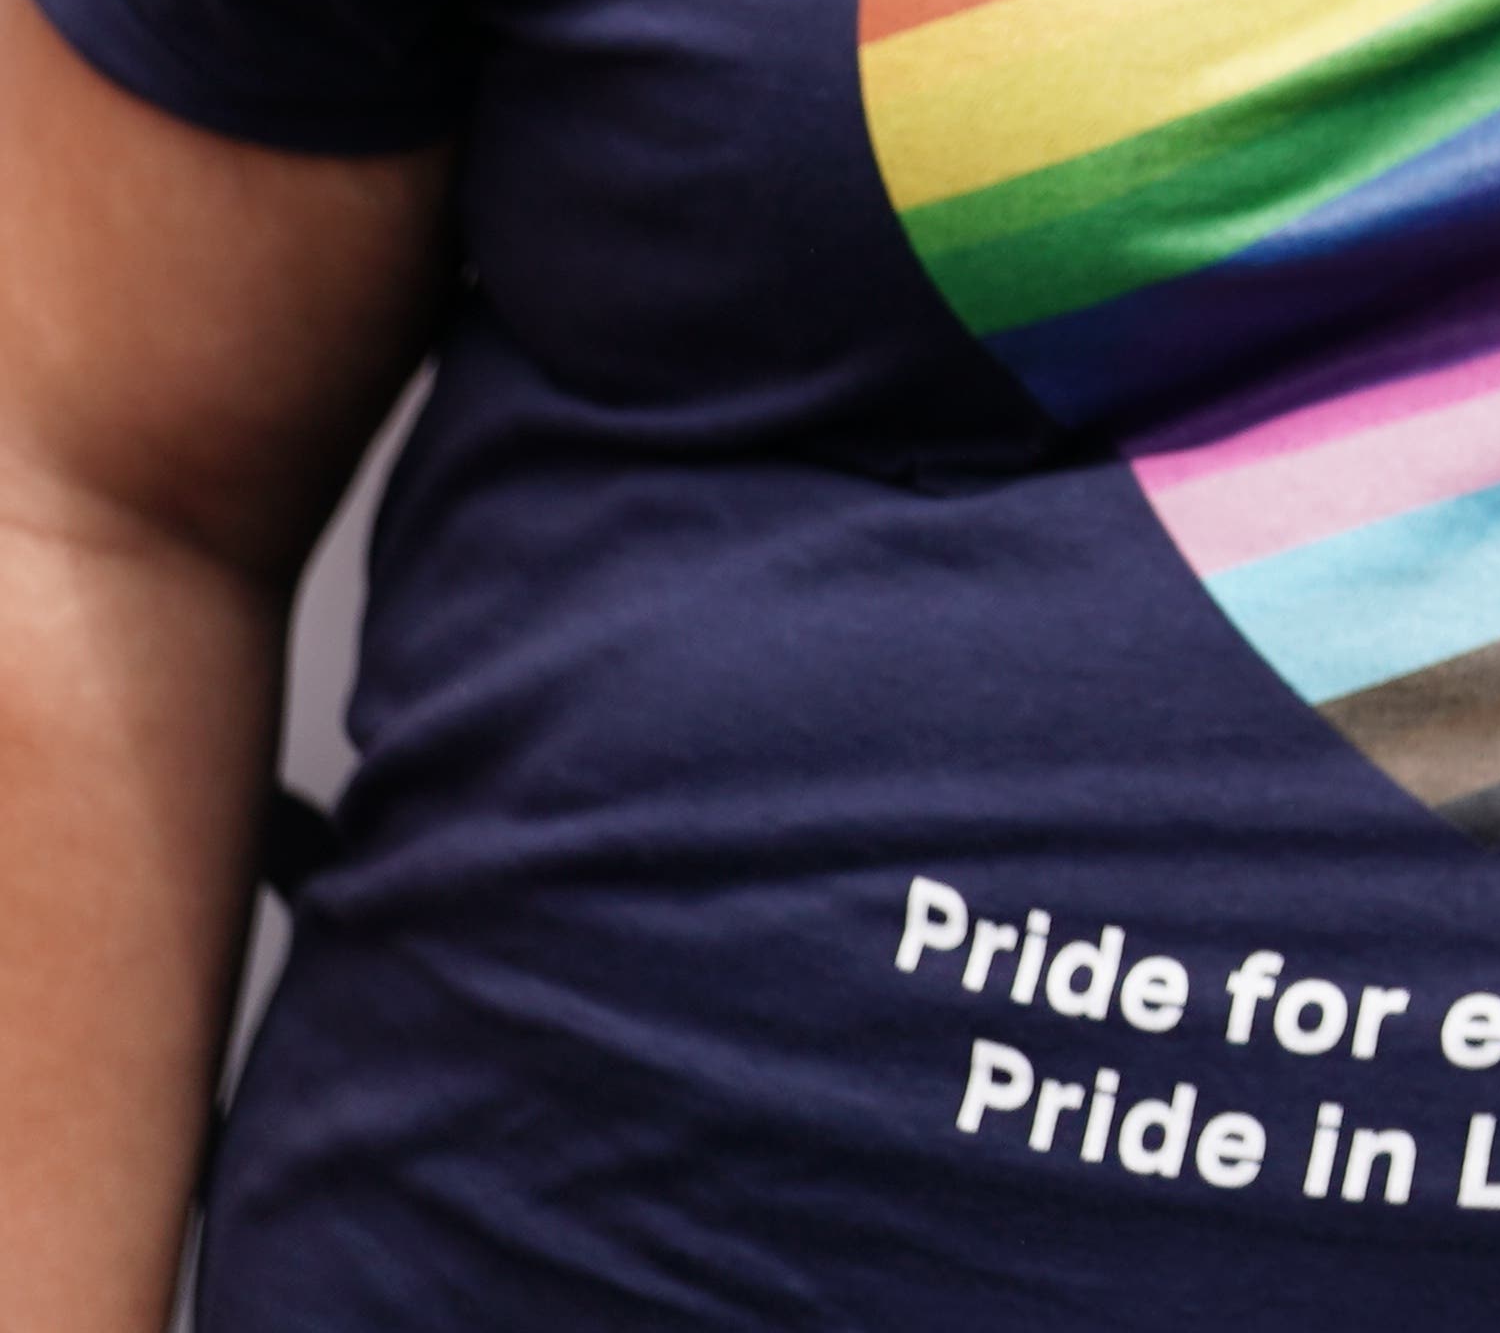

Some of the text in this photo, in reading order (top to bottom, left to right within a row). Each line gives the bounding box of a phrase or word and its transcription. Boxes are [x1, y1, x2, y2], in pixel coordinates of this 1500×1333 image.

[894, 875, 1190, 1032] Pride
[1224, 950, 1412, 1060] for
[955, 1039, 1267, 1189] Pride
[1302, 1102, 1418, 1205] in
